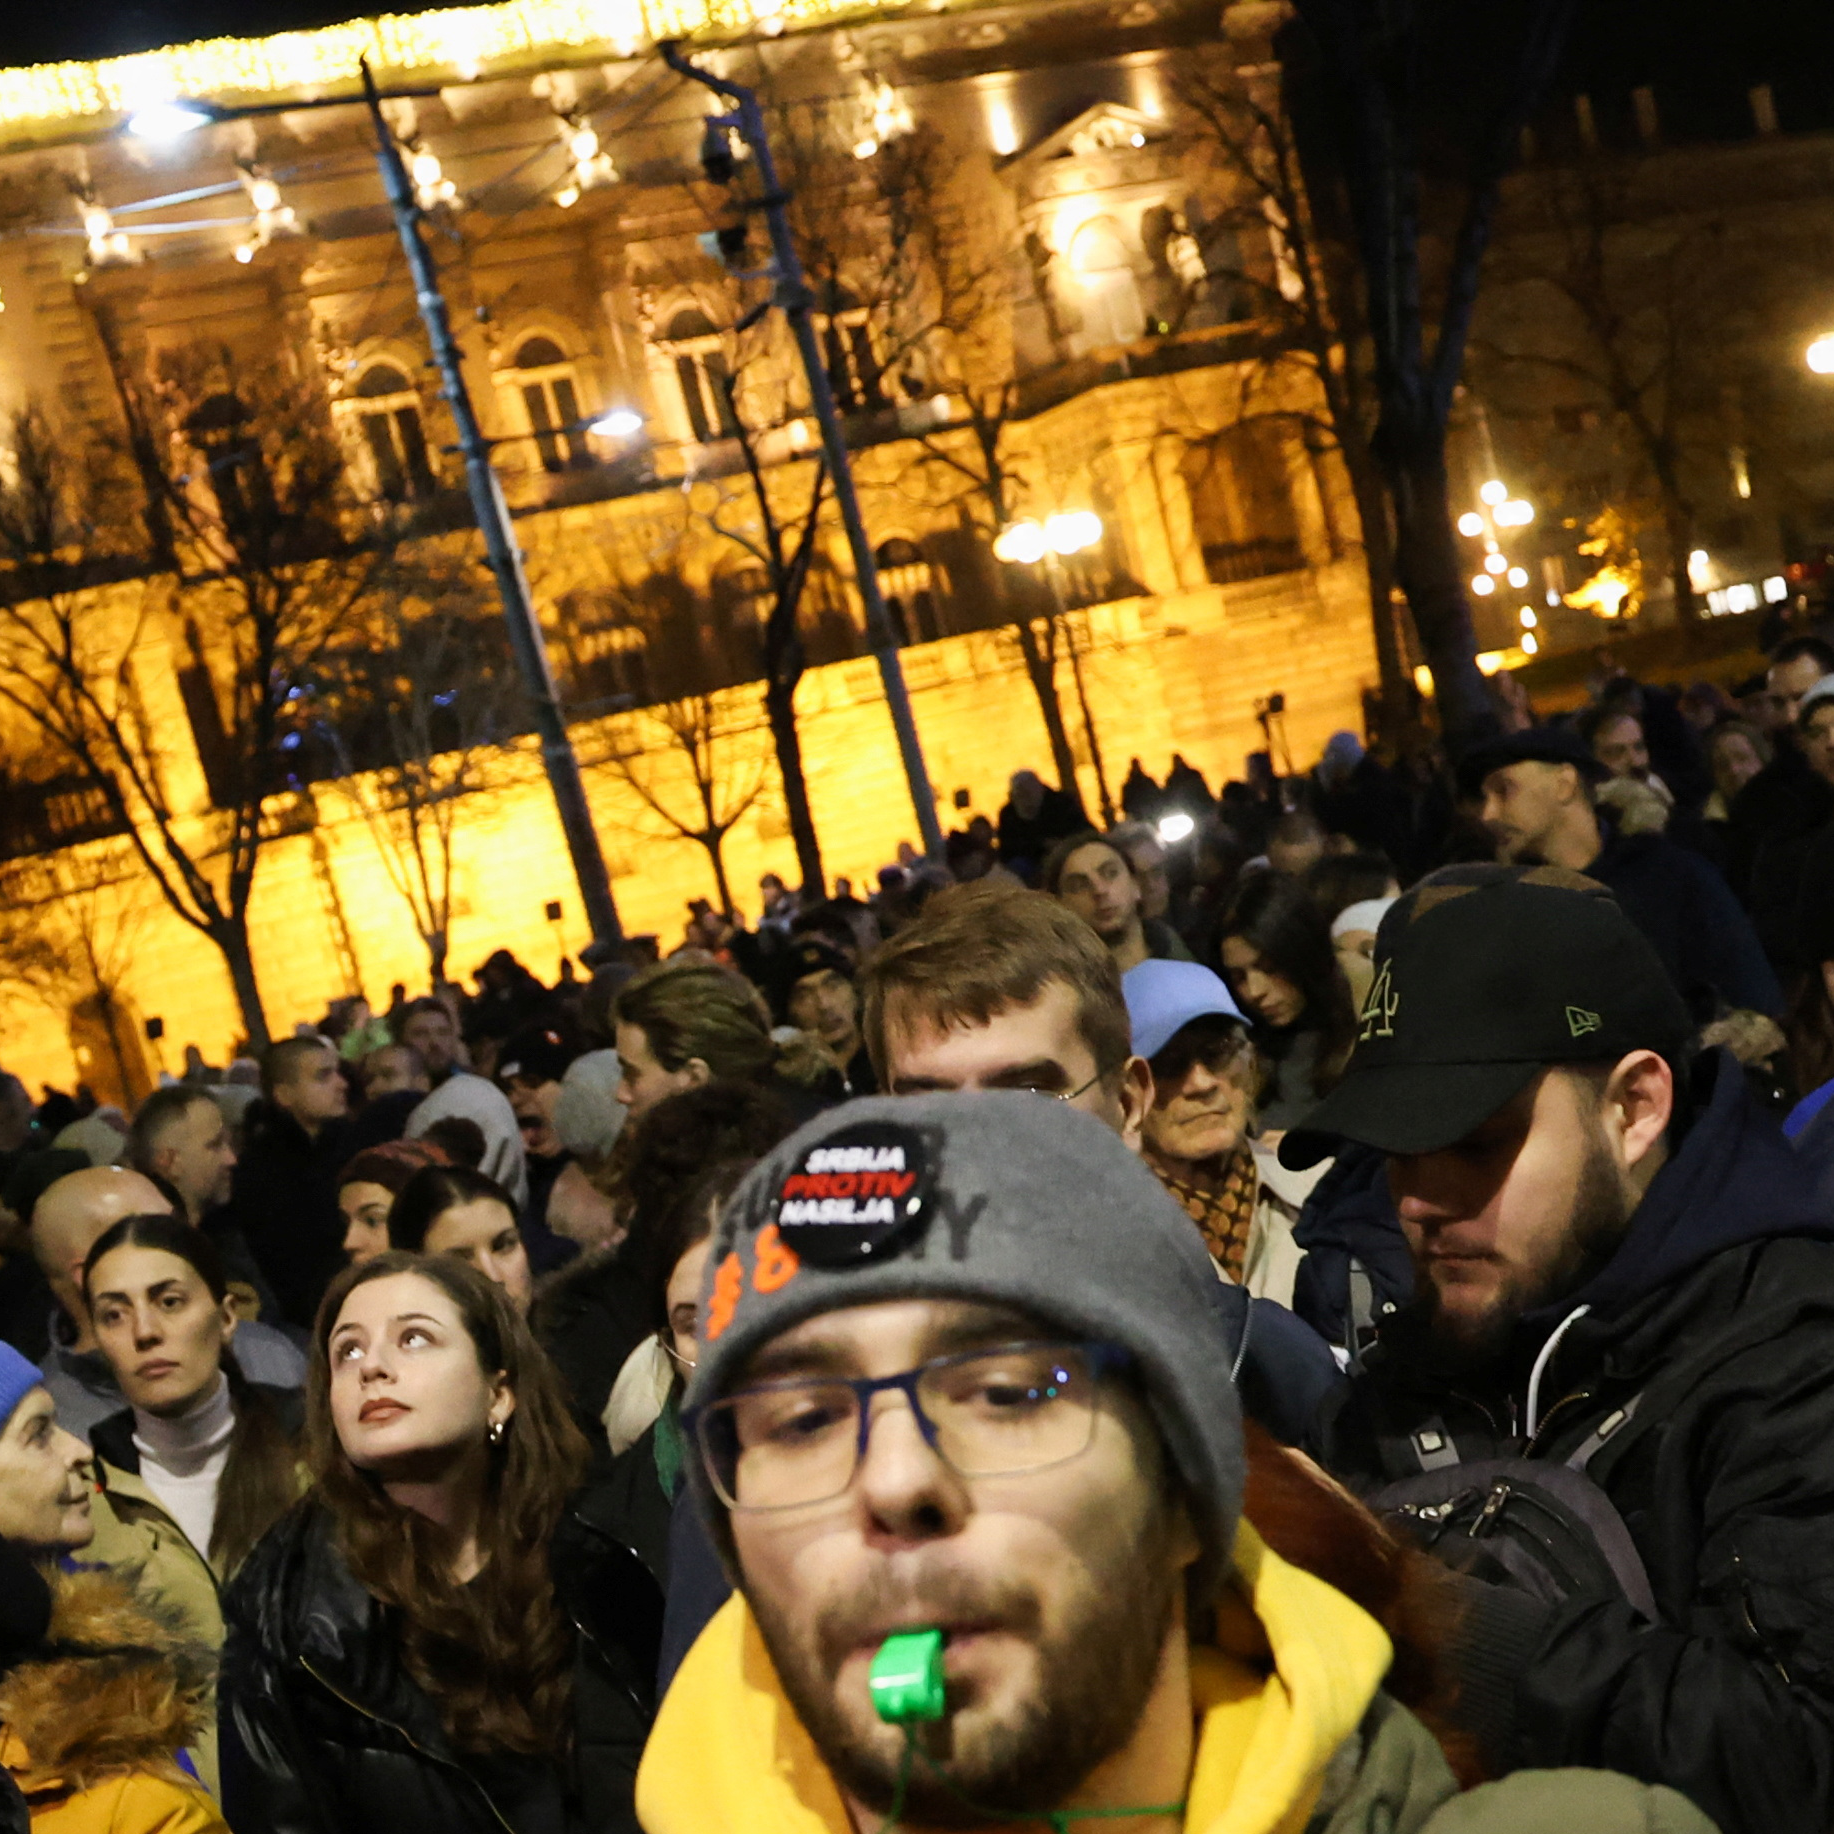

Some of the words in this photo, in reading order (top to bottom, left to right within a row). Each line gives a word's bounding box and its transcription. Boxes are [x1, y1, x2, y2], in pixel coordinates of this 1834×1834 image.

[804, 1146, 906, 1174] SRBIJA
[781, 1171, 916, 1200] PROTIV
[778, 1197, 896, 1226] NASILJA
